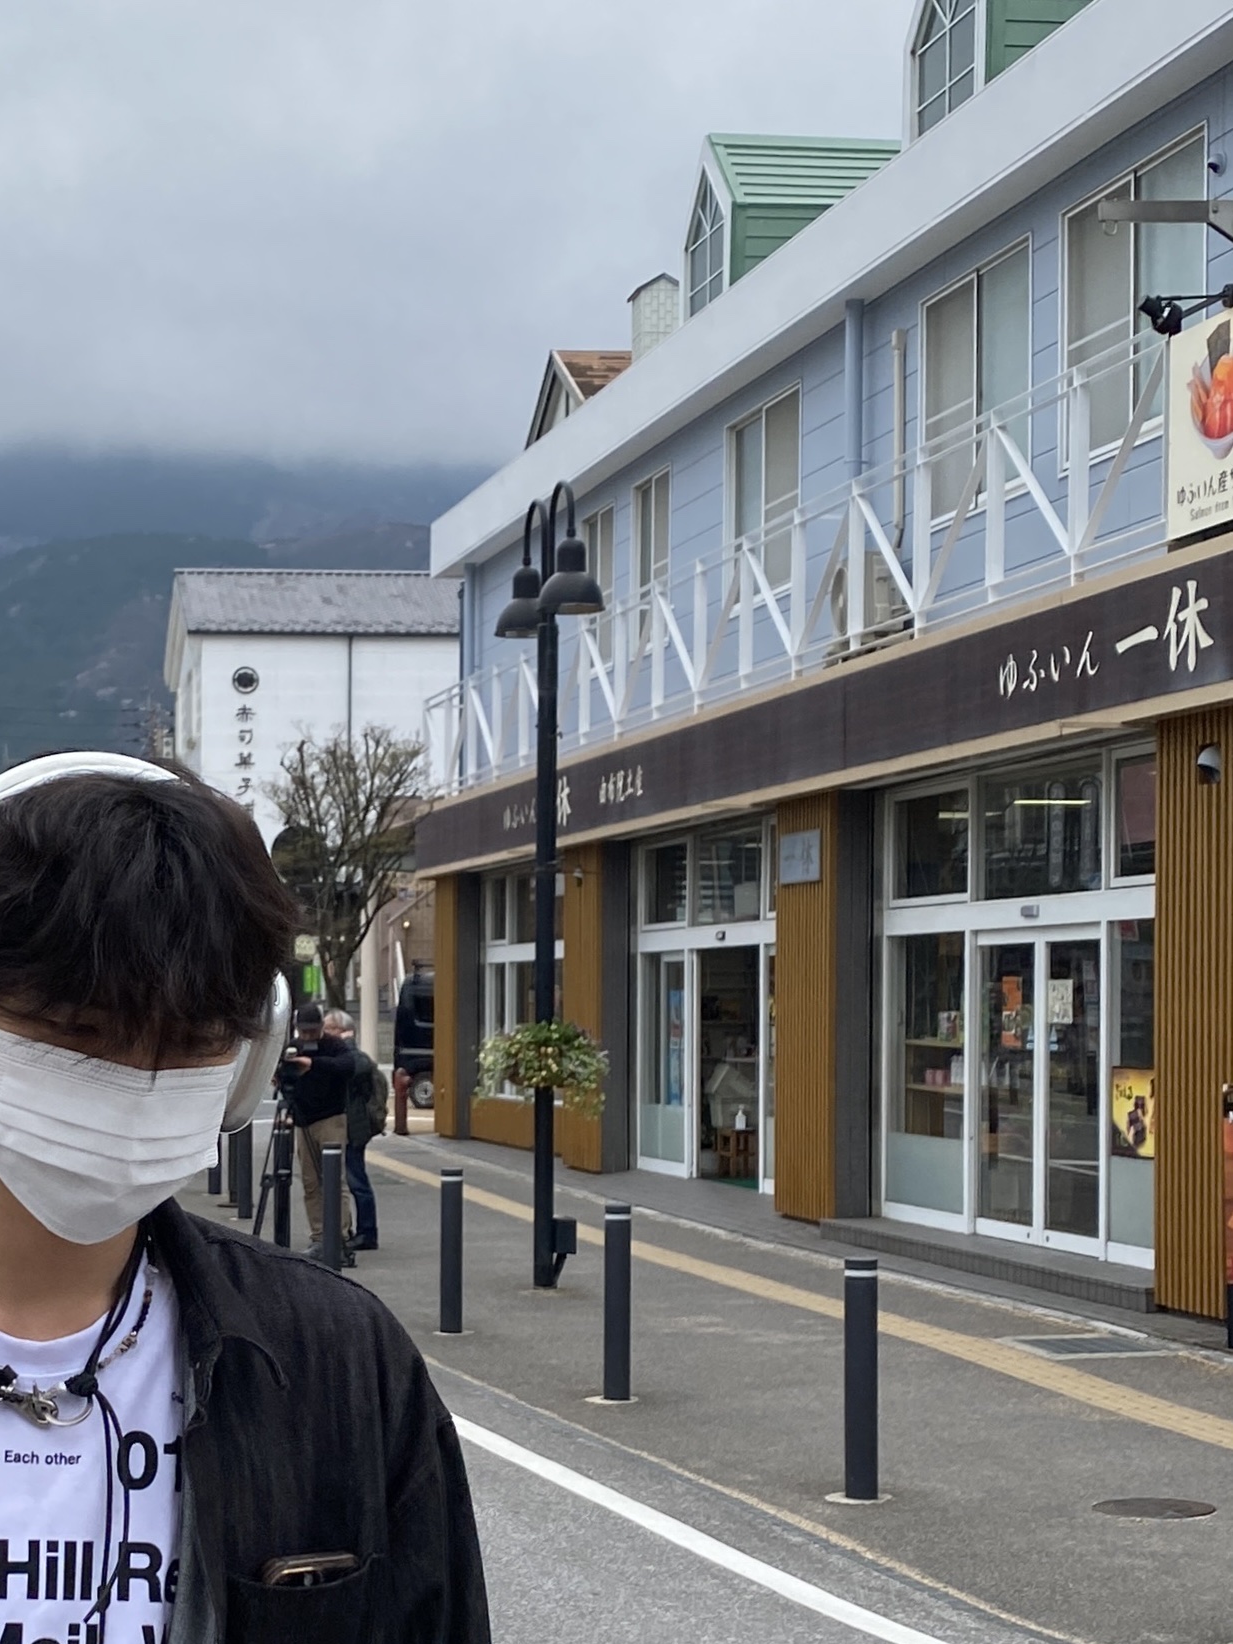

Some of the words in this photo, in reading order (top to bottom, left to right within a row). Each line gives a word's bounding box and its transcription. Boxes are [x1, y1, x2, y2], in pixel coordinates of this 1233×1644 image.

[1177, 470, 1233, 506] ゆふいん産
[999, 631, 1100, 699] ゆふいん
[1115, 580, 1215, 672] 一休
[4, 1449, 40, 1465] Each
[45, 1451, 82, 1466] other
